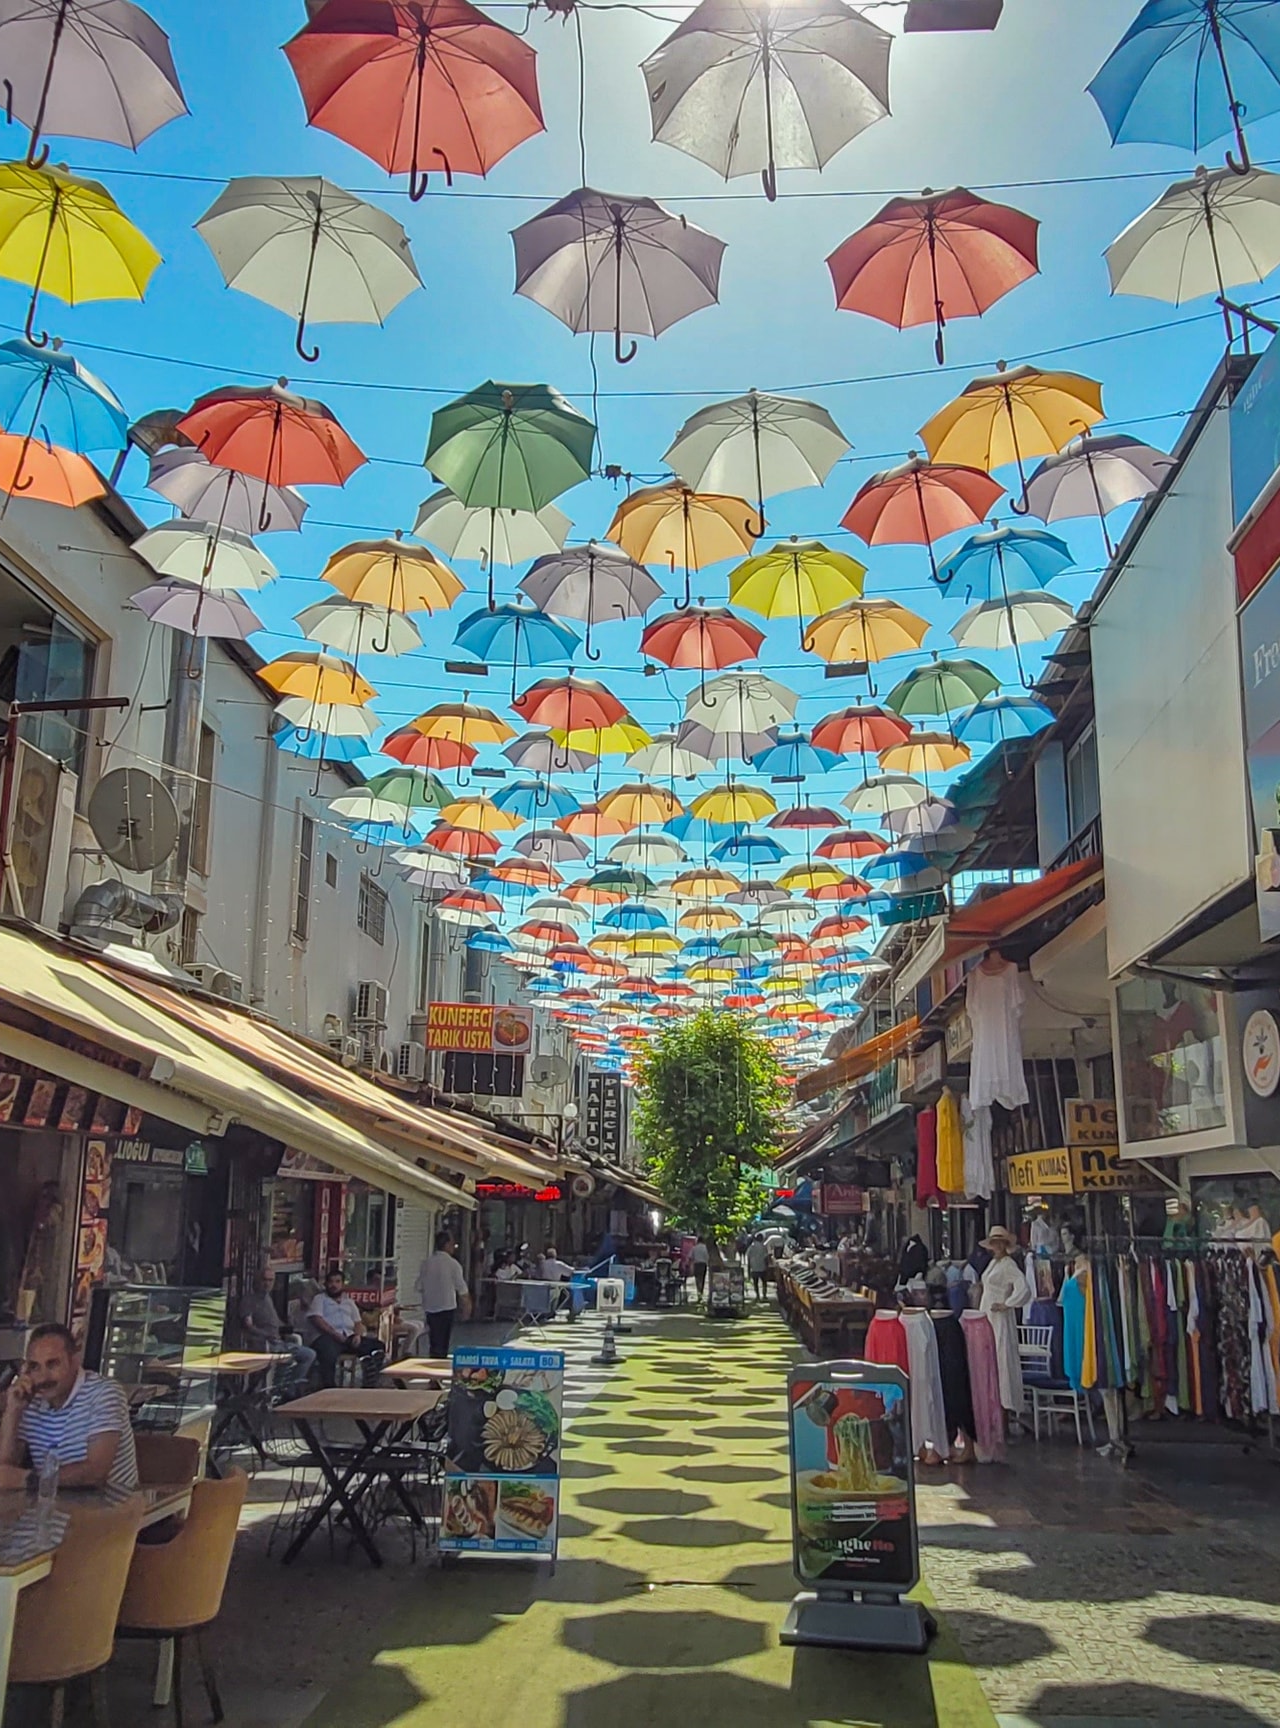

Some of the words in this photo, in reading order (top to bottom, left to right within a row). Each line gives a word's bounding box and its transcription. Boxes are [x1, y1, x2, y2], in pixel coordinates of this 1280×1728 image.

[428, 1028, 461, 1048] TARIK
[463, 1030, 492, 1049] USTA
[603, 1077, 619, 1162] PIERCING
